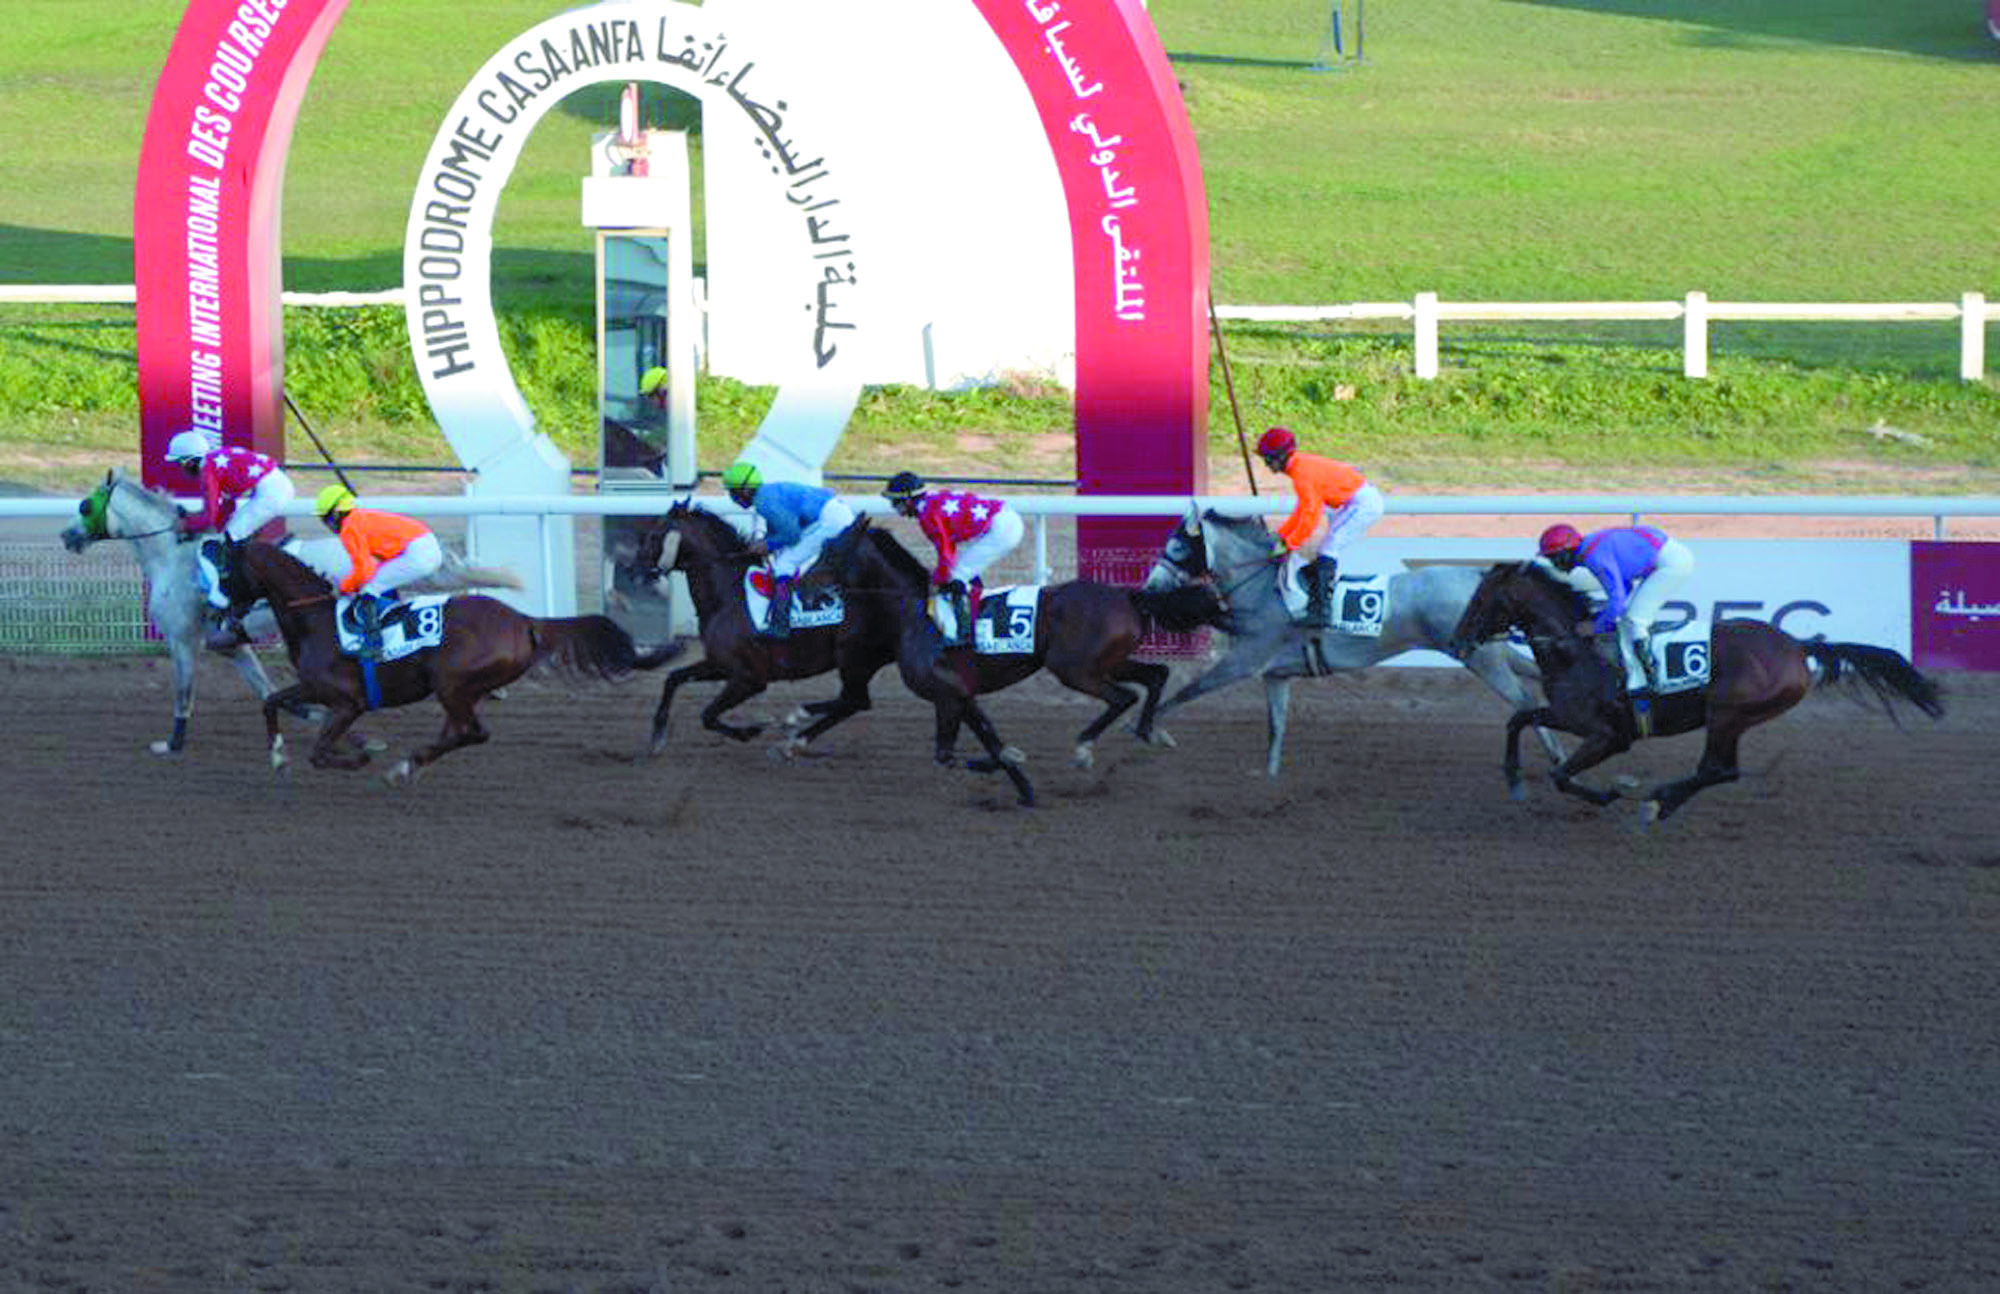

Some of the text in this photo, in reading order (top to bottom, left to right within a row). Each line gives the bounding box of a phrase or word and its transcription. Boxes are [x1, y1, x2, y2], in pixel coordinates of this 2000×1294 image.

[187, 105, 232, 170] DES
[1069, 112, 1139, 209] الدولي
[656, 16, 857, 369] حلبة الدار البيضاء أنفا
[187, 175, 222, 347] INTERNATIONAL
[418, 115, 503, 380] HIPPODROME
[417, 607, 440, 637] 8
[1008, 608, 1031, 639] 5
[1359, 592, 1382, 622] 9
[1683, 643, 1707, 677] 6
